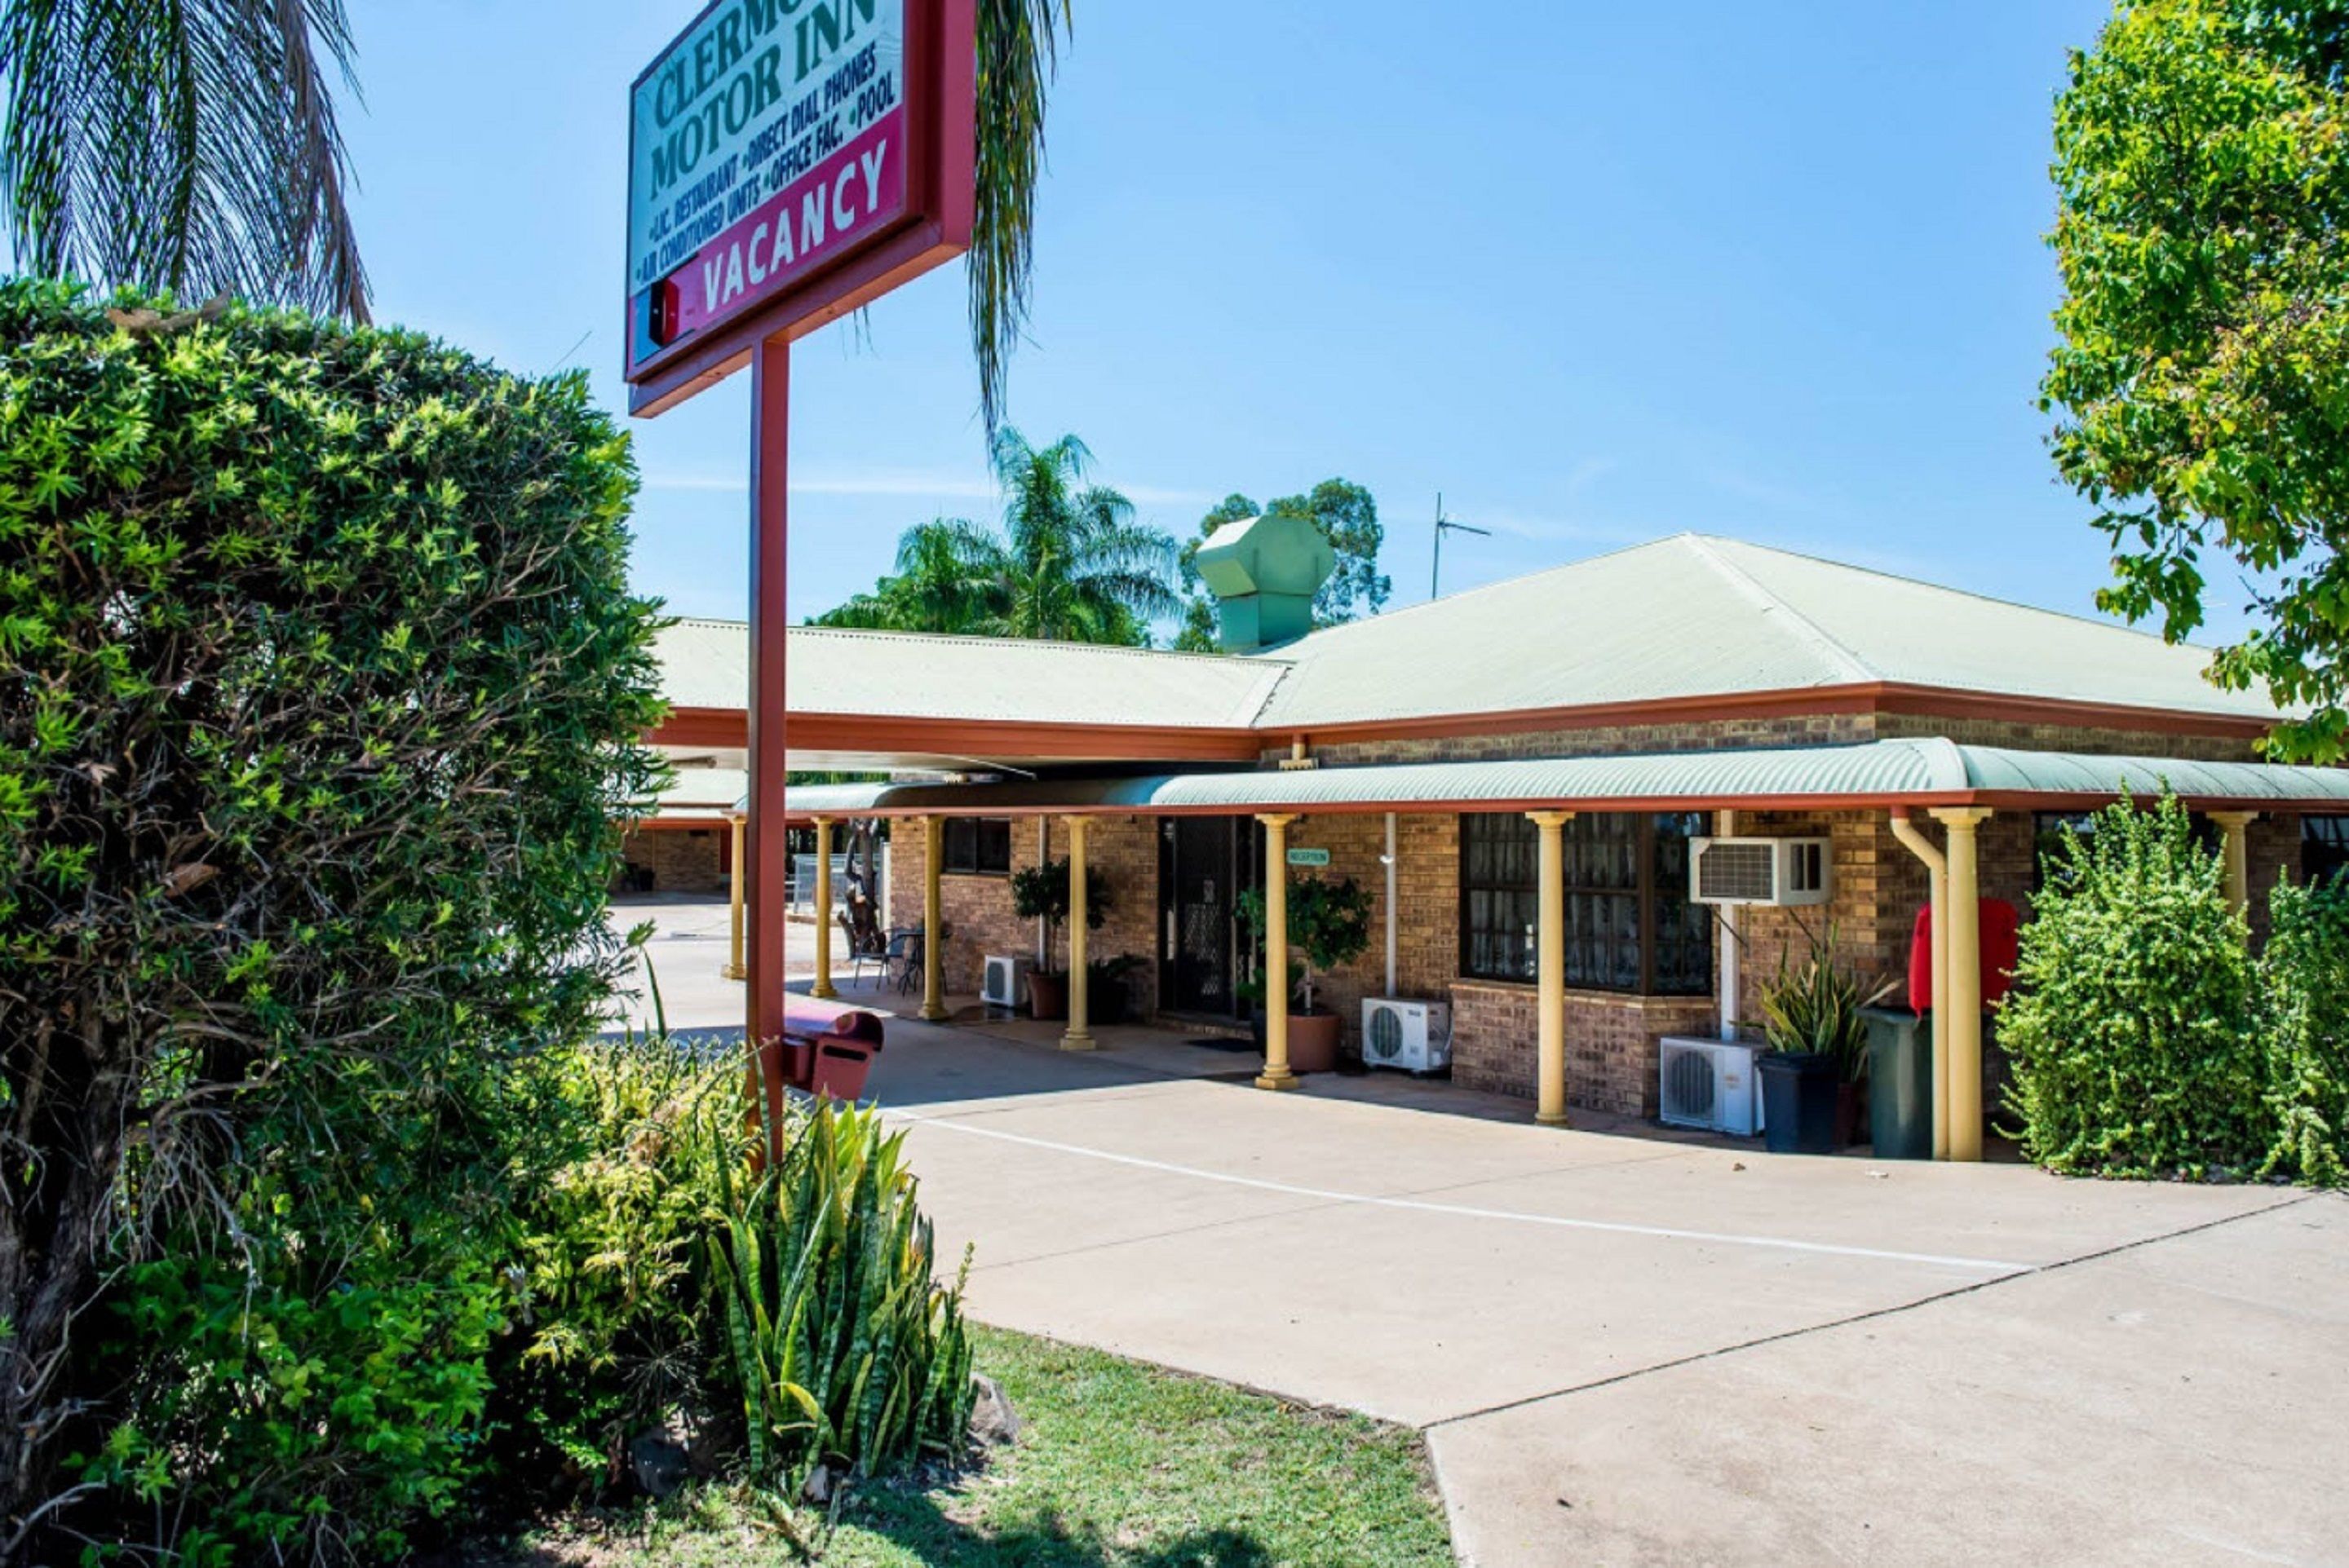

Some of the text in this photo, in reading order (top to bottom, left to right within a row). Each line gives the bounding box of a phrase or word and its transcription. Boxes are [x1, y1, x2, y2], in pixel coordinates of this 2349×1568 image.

[650, 0, 875, 201] MOTOR INN
[656, 0, 802, 128] CLERM
[675, 153, 737, 228] RESTAURANT
[748, 113, 788, 171] DIRECT
[791, 89, 819, 138] DIAL
[824, 39, 875, 113] PHONES
[643, 69, 896, 283] AIR CONDITIONED UNITS OFFICE FAC. POOL
[704, 139, 887, 313] VACANCY
